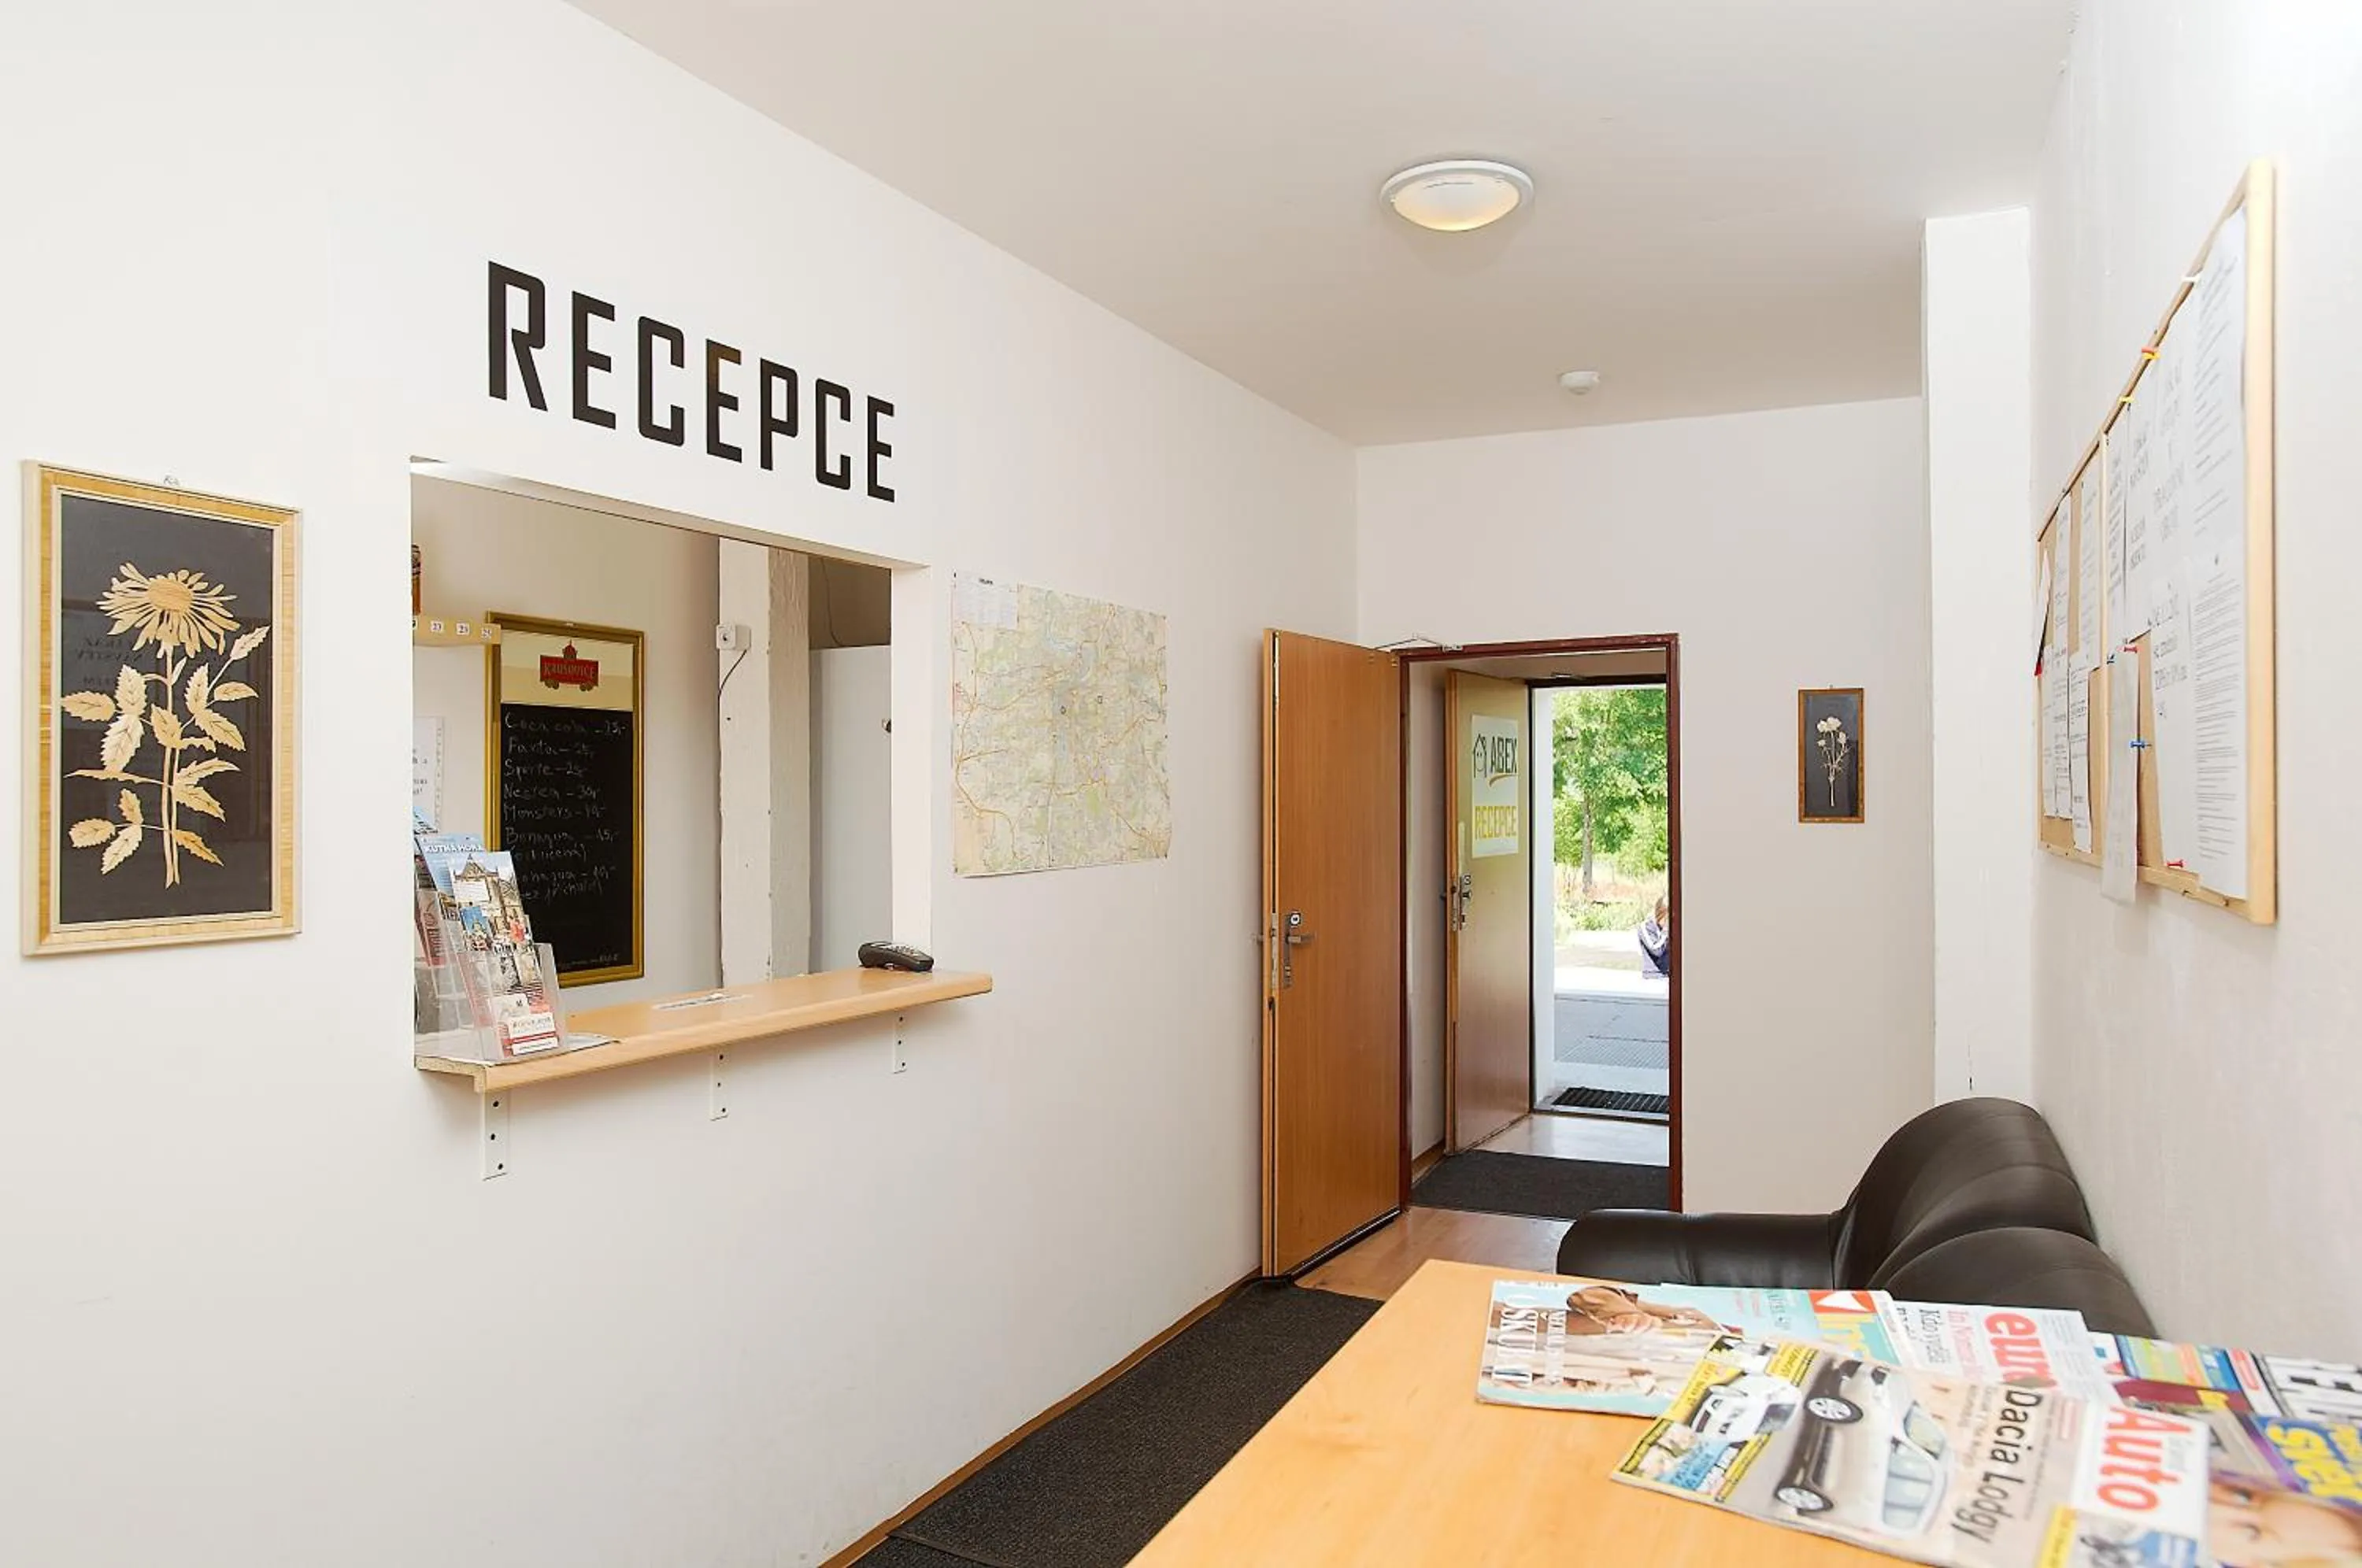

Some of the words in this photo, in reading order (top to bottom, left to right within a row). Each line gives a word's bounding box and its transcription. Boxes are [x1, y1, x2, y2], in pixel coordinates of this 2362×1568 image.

[488, 261, 894, 502] RECEPCE
[1490, 735, 1517, 775] ABEX
[1475, 805, 1517, 839] RECEPCE
[1990, 1389, 2045, 1466] Dacia
[2096, 1406, 2193, 1512] Auto
[1950, 1470, 2027, 1544] Lodgy
